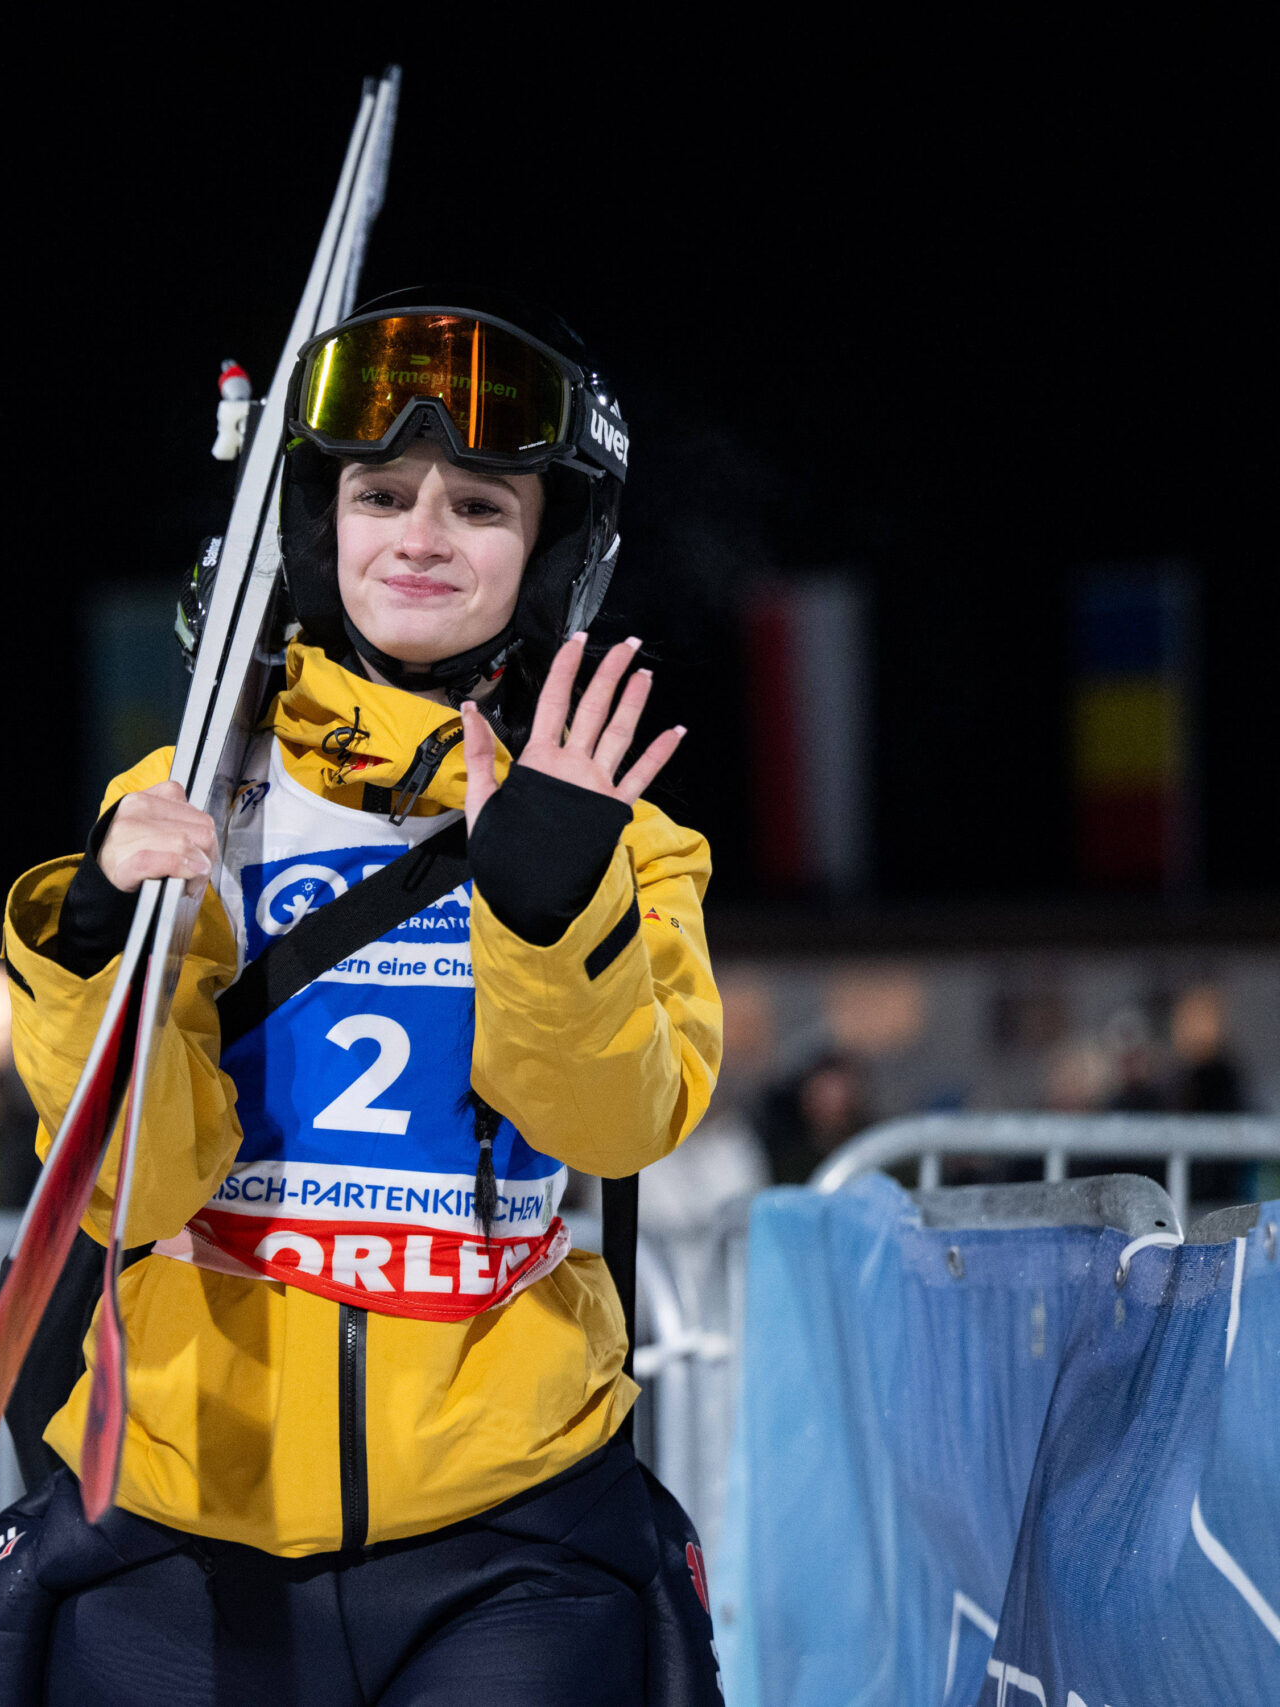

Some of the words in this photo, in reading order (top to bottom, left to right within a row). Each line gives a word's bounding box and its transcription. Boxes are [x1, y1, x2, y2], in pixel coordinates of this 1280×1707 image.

[377, 957, 427, 976] eine
[312, 1013, 412, 1136] 2
[254, 1230, 532, 1295] ORLEN
